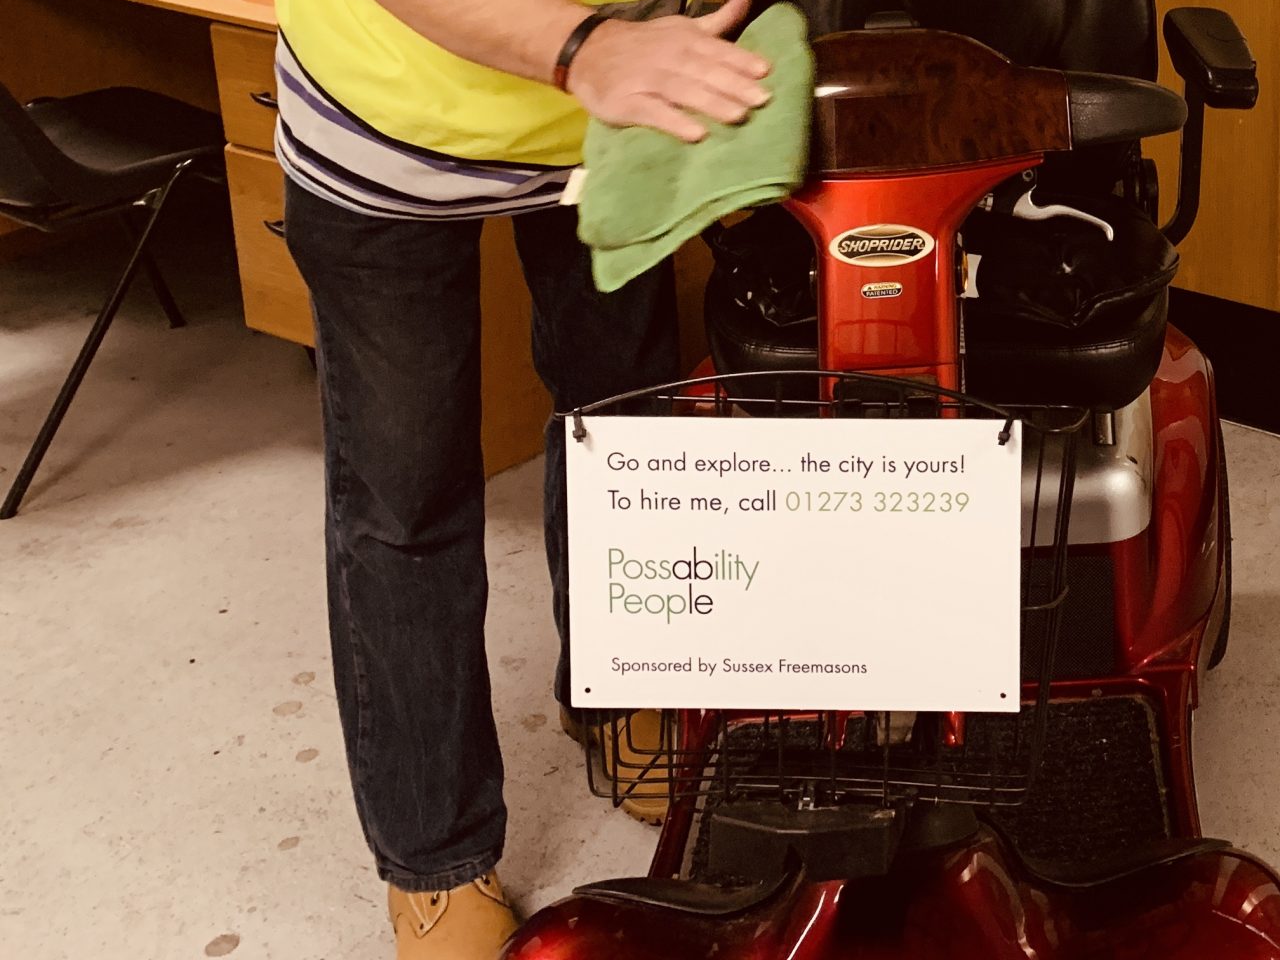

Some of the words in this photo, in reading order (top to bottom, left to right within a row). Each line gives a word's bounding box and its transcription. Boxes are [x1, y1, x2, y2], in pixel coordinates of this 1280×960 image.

[839, 238, 922, 253] SHOPRIDER
[866, 289, 899, 297] PATENTED
[606, 451, 640, 472] Go
[648, 451, 687, 472] and
[694, 451, 792, 477] explore...
[800, 452, 831, 474] the
[838, 455, 875, 479] city
[882, 455, 897, 474] is
[904, 454, 966, 479] yours!
[607, 489, 632, 511] To
[640, 489, 682, 511] hire
[690, 496, 729, 515] me,
[738, 489, 777, 512] call
[785, 491, 864, 513] 01273
[873, 491, 970, 513] 323239
[608, 546, 760, 591] Possability
[608, 582, 715, 625] People
[611, 656, 692, 675] Sponsored
[698, 657, 717, 676] by
[723, 658, 774, 674] Sussex
[779, 659, 868, 675] Freemasons
